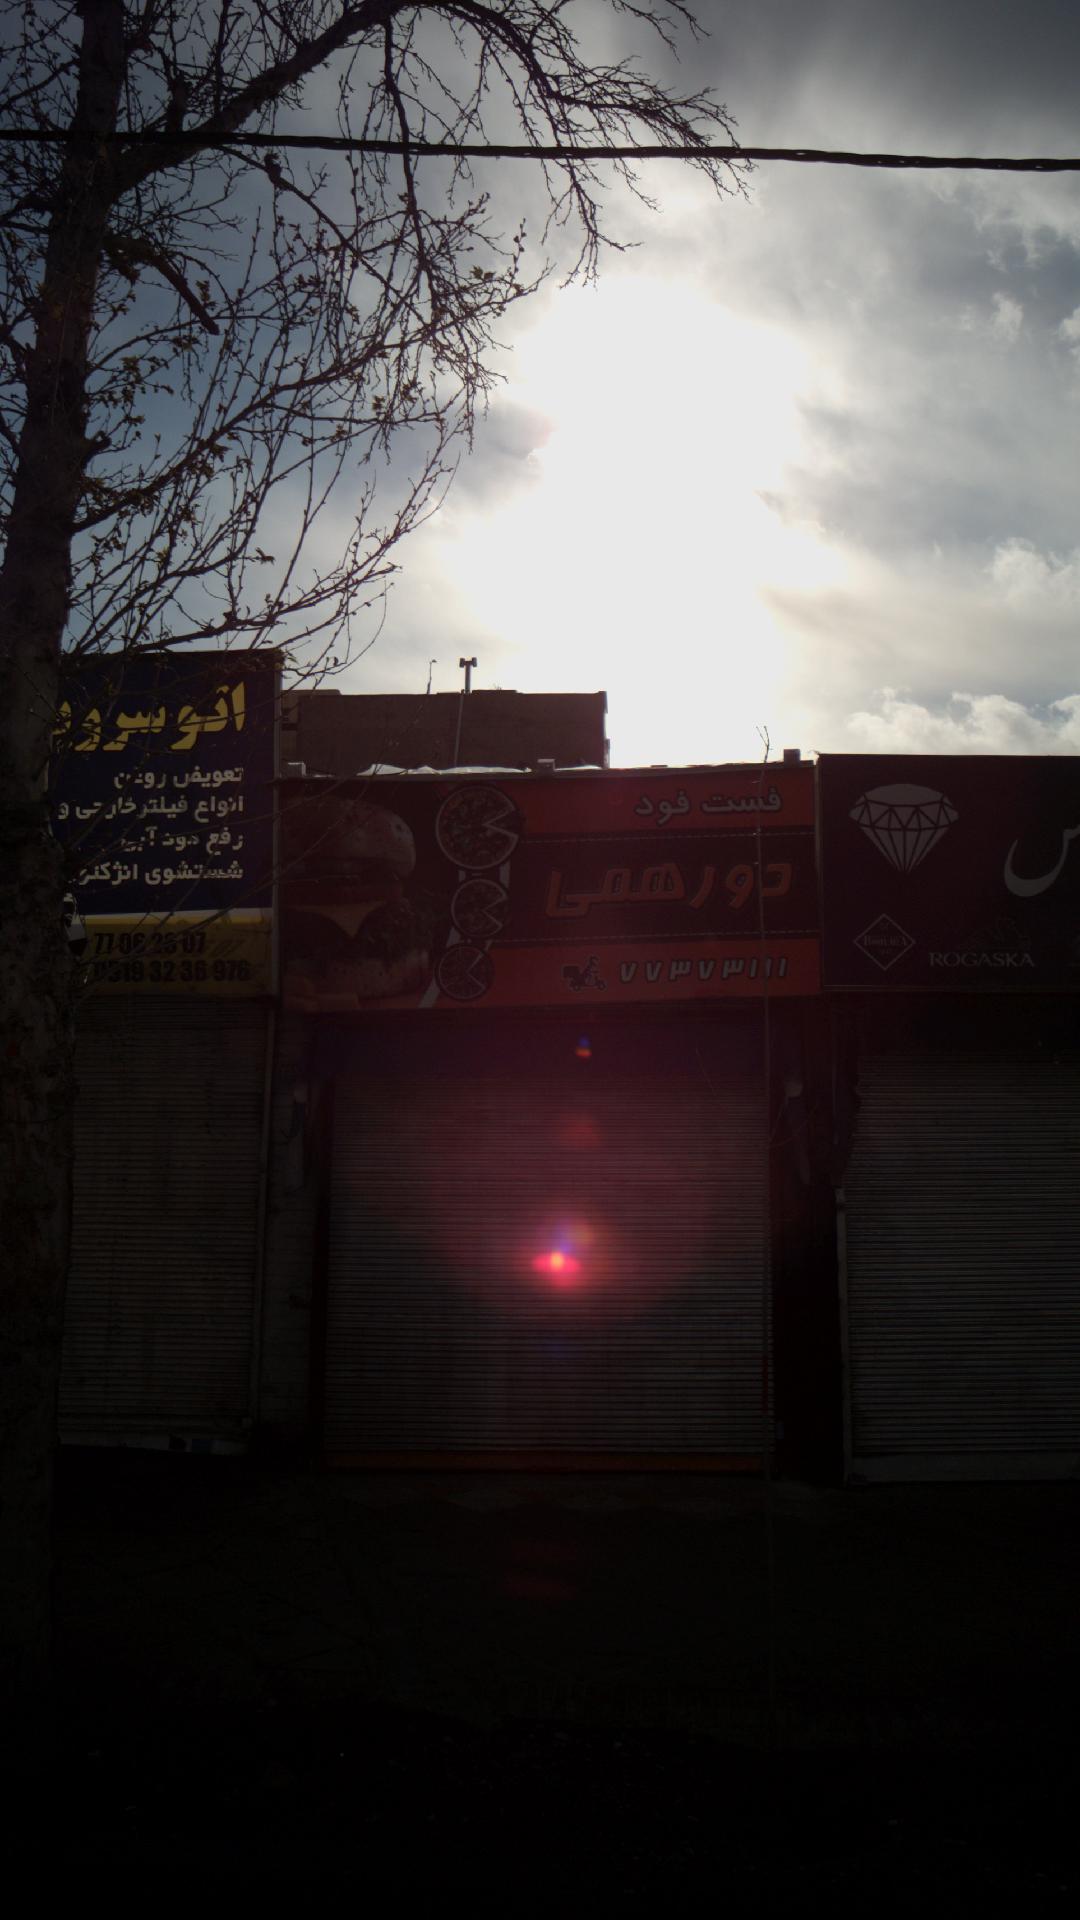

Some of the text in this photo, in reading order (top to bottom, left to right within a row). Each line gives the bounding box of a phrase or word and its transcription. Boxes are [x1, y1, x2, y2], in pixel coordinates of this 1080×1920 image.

[172, 765, 244, 789] تعویض
[137, 794, 189, 820] فیلتر
[194, 795, 244, 824] انواع
[634, 786, 782, 825] فست فود
[206, 826, 244, 855] رفع
[144, 860, 244, 886] شستشوی
[619, 956, 788, 983] ۷۷۳۷۳۱۱۱
[928, 951, 1036, 968] ROGASKA
